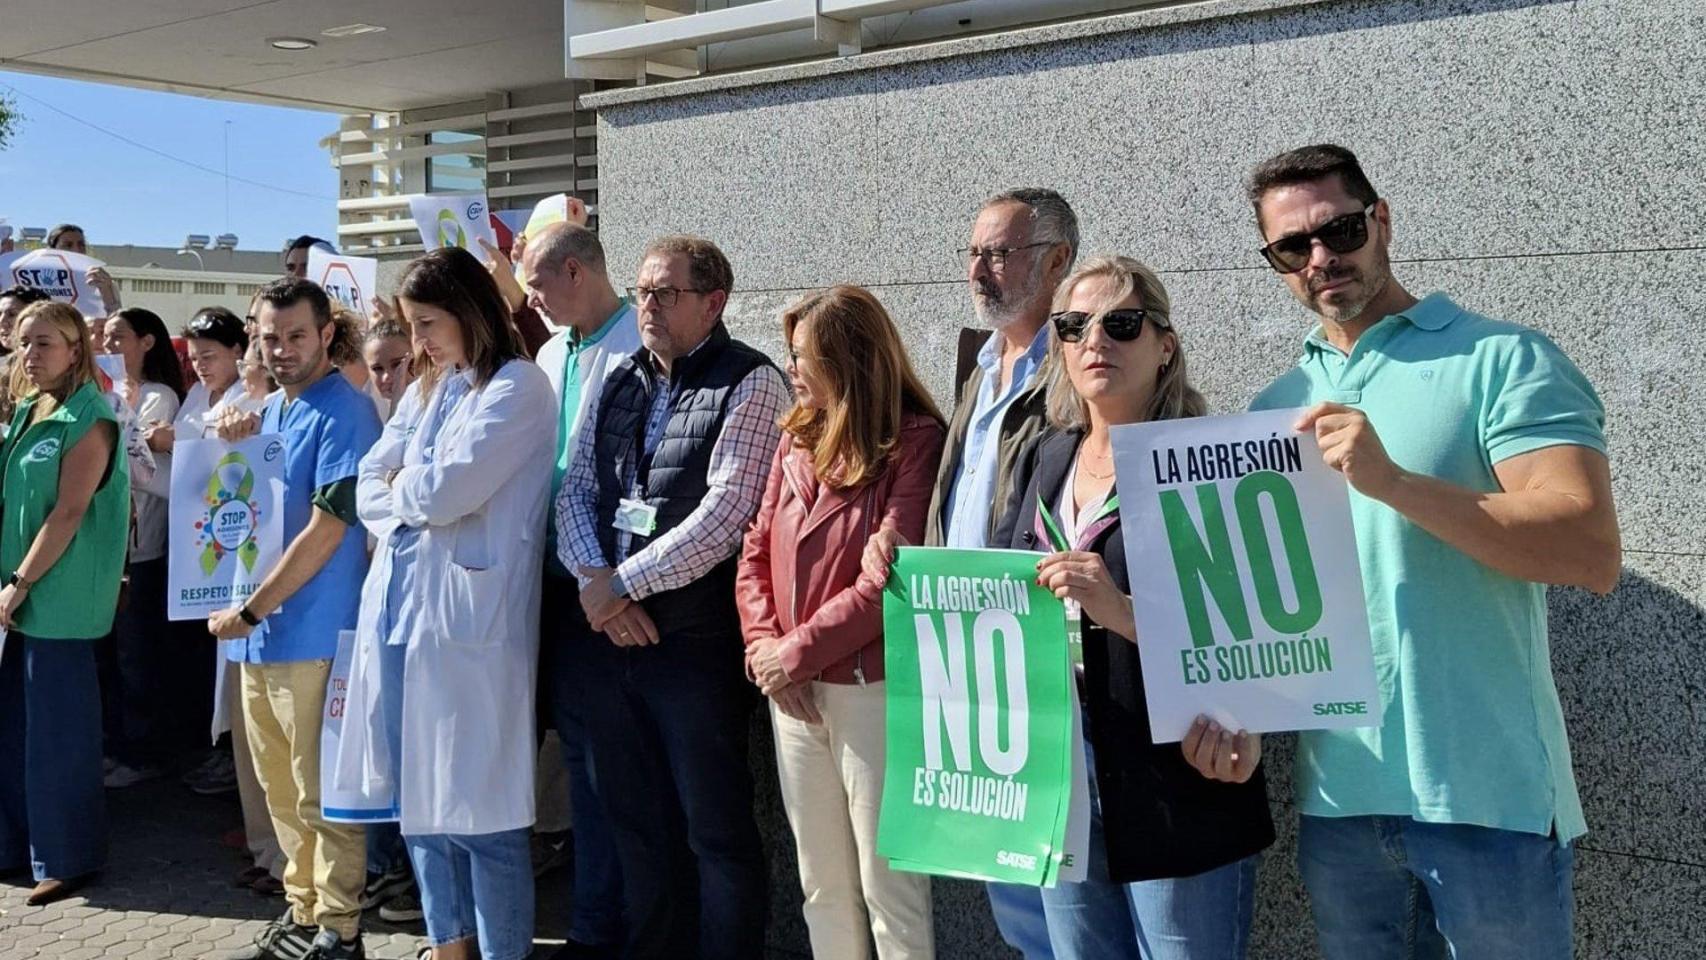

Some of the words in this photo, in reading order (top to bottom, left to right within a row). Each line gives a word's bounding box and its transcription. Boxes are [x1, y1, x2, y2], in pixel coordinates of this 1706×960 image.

[1153, 448, 1182, 485] LA
[1187, 432, 1302, 482] AGRESIÓN
[221, 510, 246, 526] STOP
[1158, 470, 1323, 648] NO
[181, 585, 228, 601] RESPETO
[911, 574, 933, 610] LA
[937, 572, 1030, 615] AGRESIÓN
[1181, 649, 1211, 685] ES
[1215, 633, 1332, 683] SOLUCIÓN
[914, 608, 1029, 775] NO
[1312, 701, 1368, 716] SATSE
[913, 767, 936, 806] ES
[938, 771, 1028, 822] SOLUCIÓN
[996, 849, 1038, 872] SATSE
